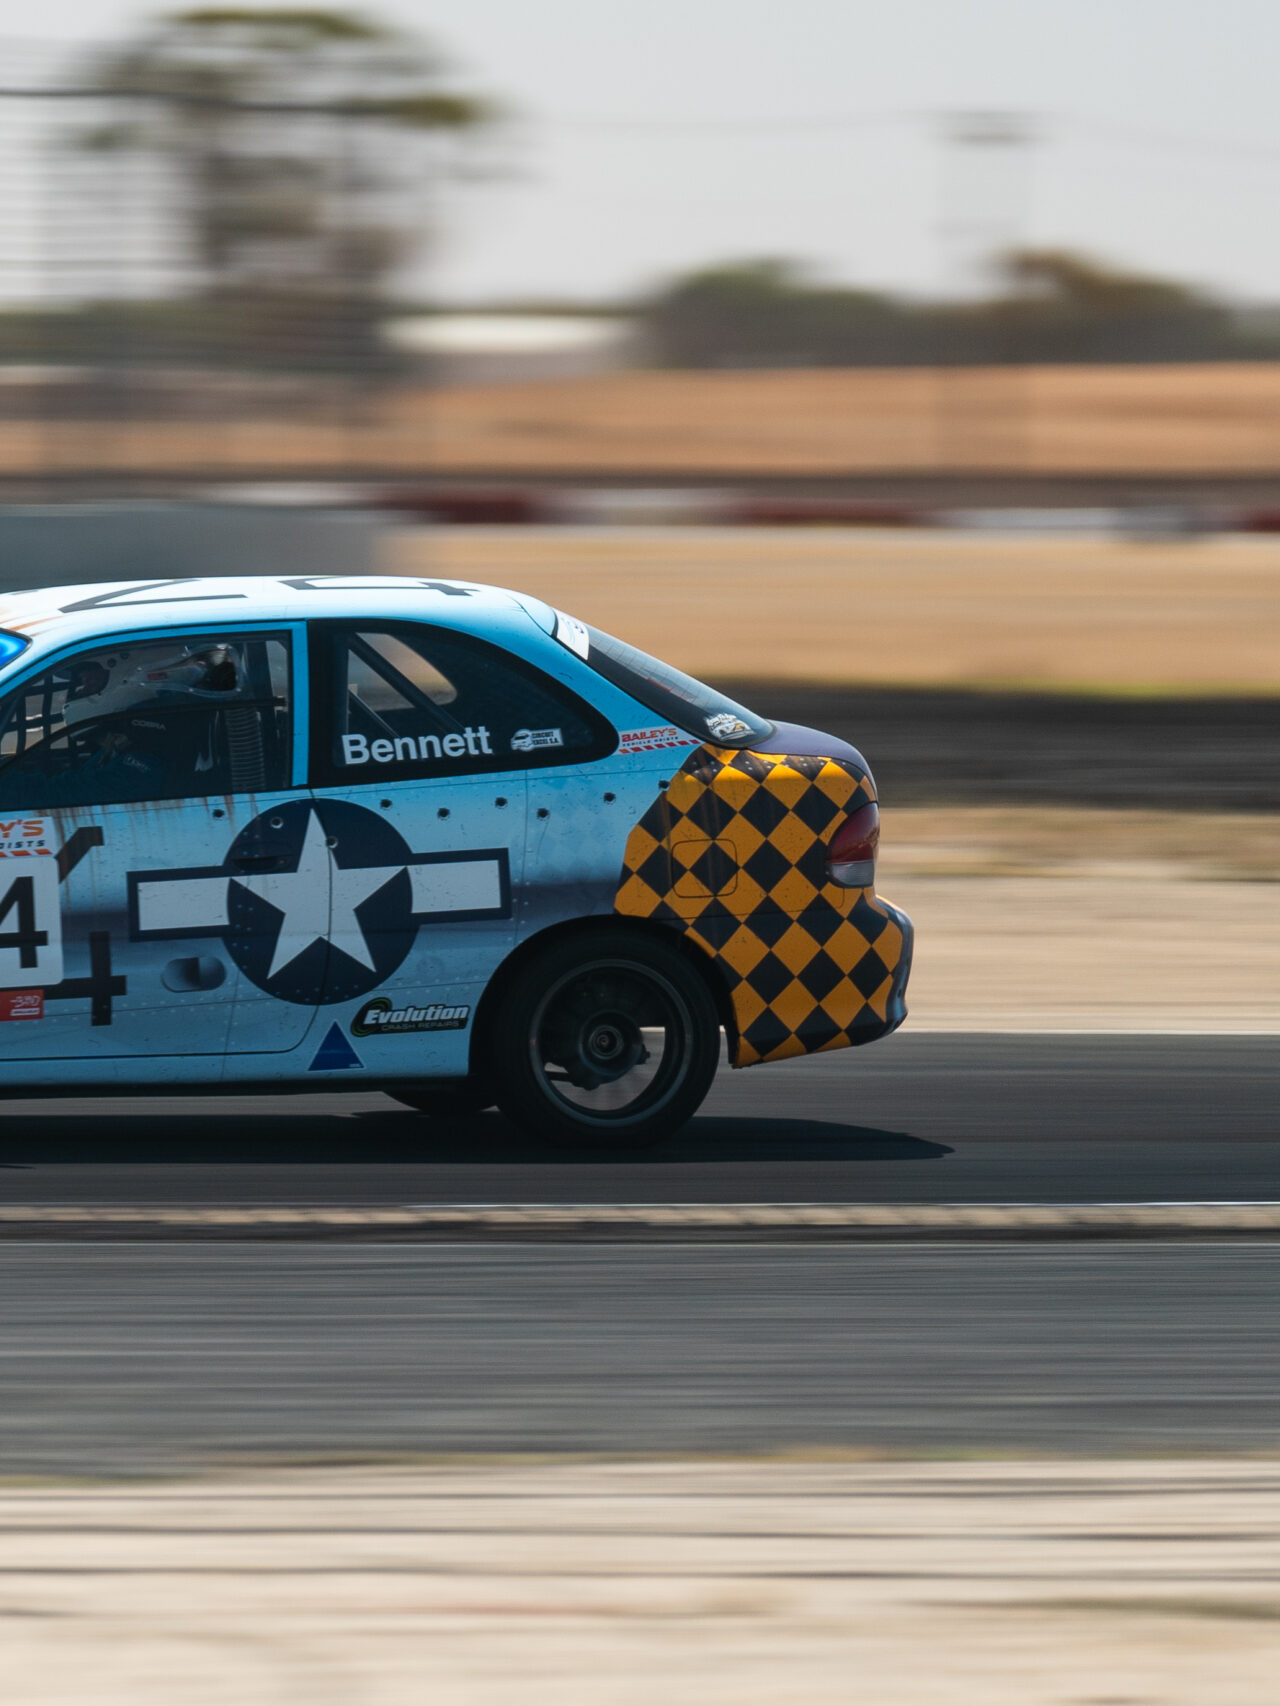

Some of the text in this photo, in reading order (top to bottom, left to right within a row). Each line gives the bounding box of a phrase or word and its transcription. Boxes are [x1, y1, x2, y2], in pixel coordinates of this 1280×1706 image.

[341, 726, 493, 765] Bennett
[622, 727, 677, 742] BAILEY'S
[363, 1003, 469, 1025] Evolution
